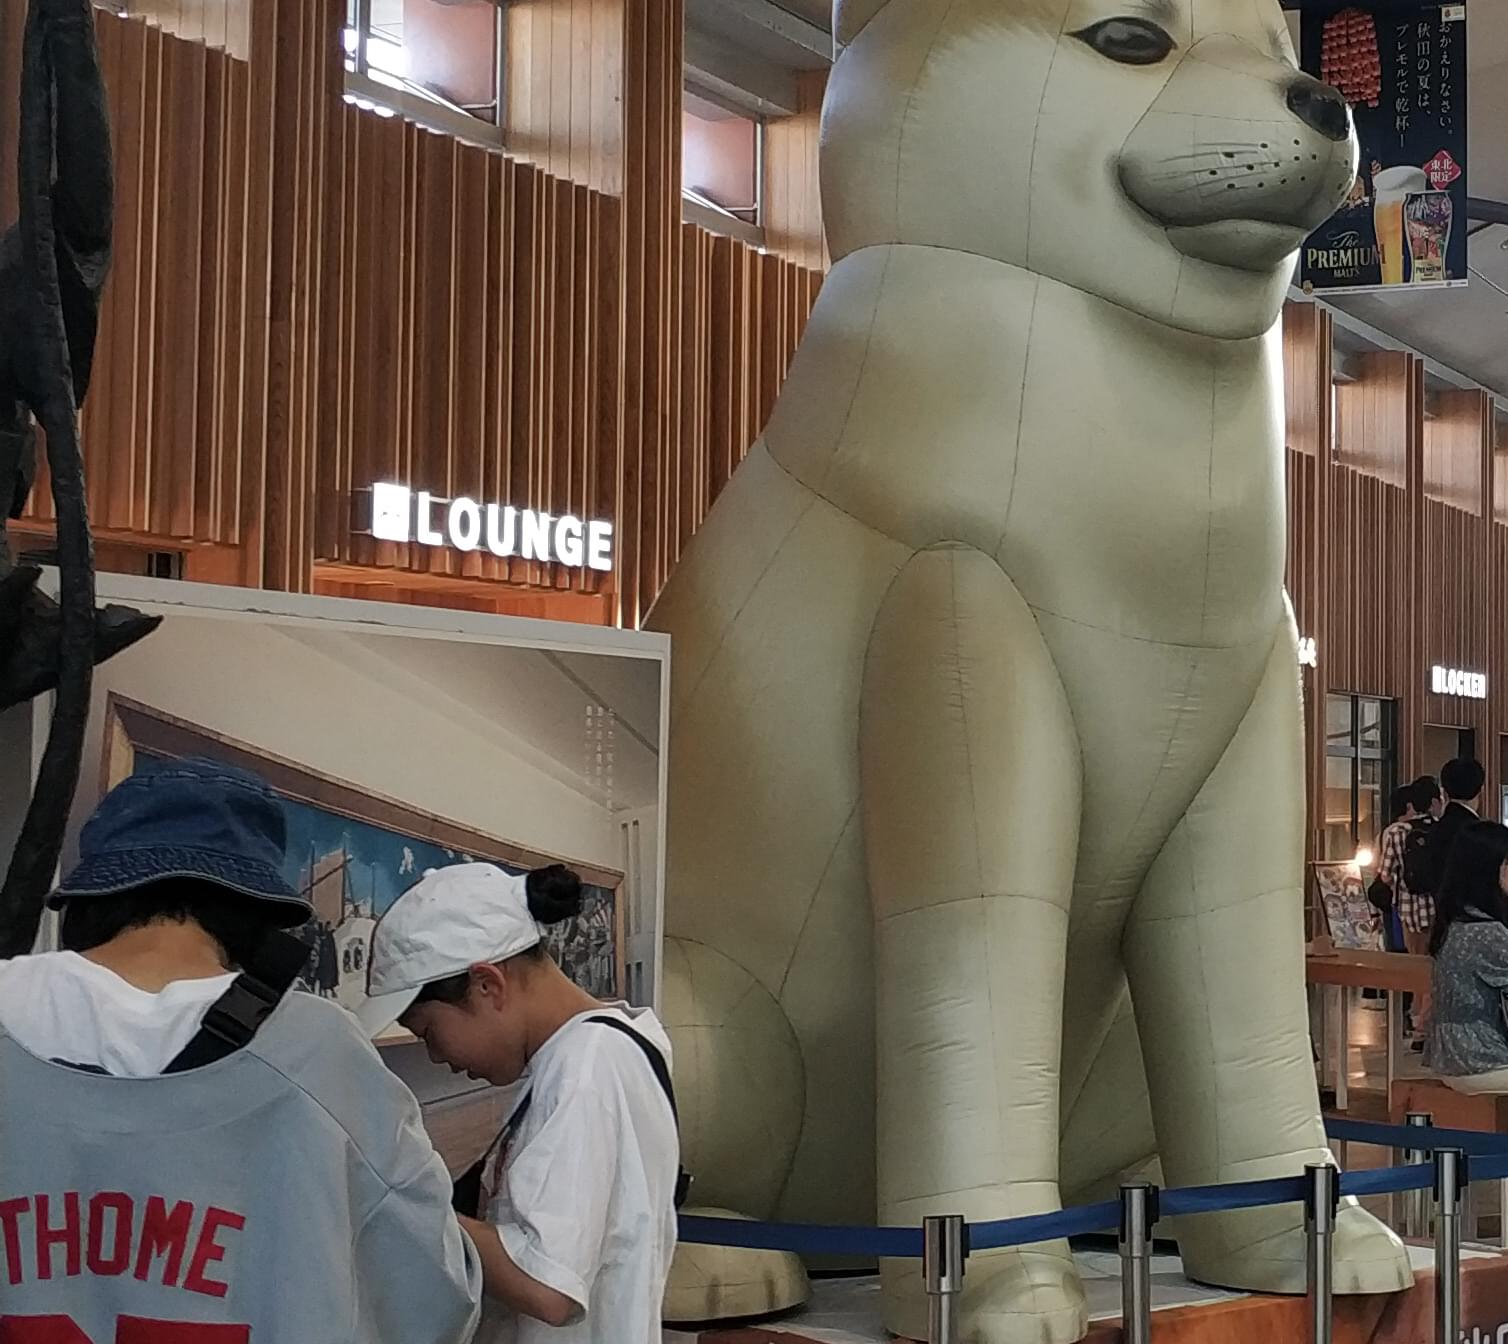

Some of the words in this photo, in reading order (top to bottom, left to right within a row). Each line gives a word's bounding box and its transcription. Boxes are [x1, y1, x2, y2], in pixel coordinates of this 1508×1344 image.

[1307, 244, 1387, 269] PREMIUM
[417, 490, 613, 571] LOUNGE
[0, 1192, 246, 1298] THOME
